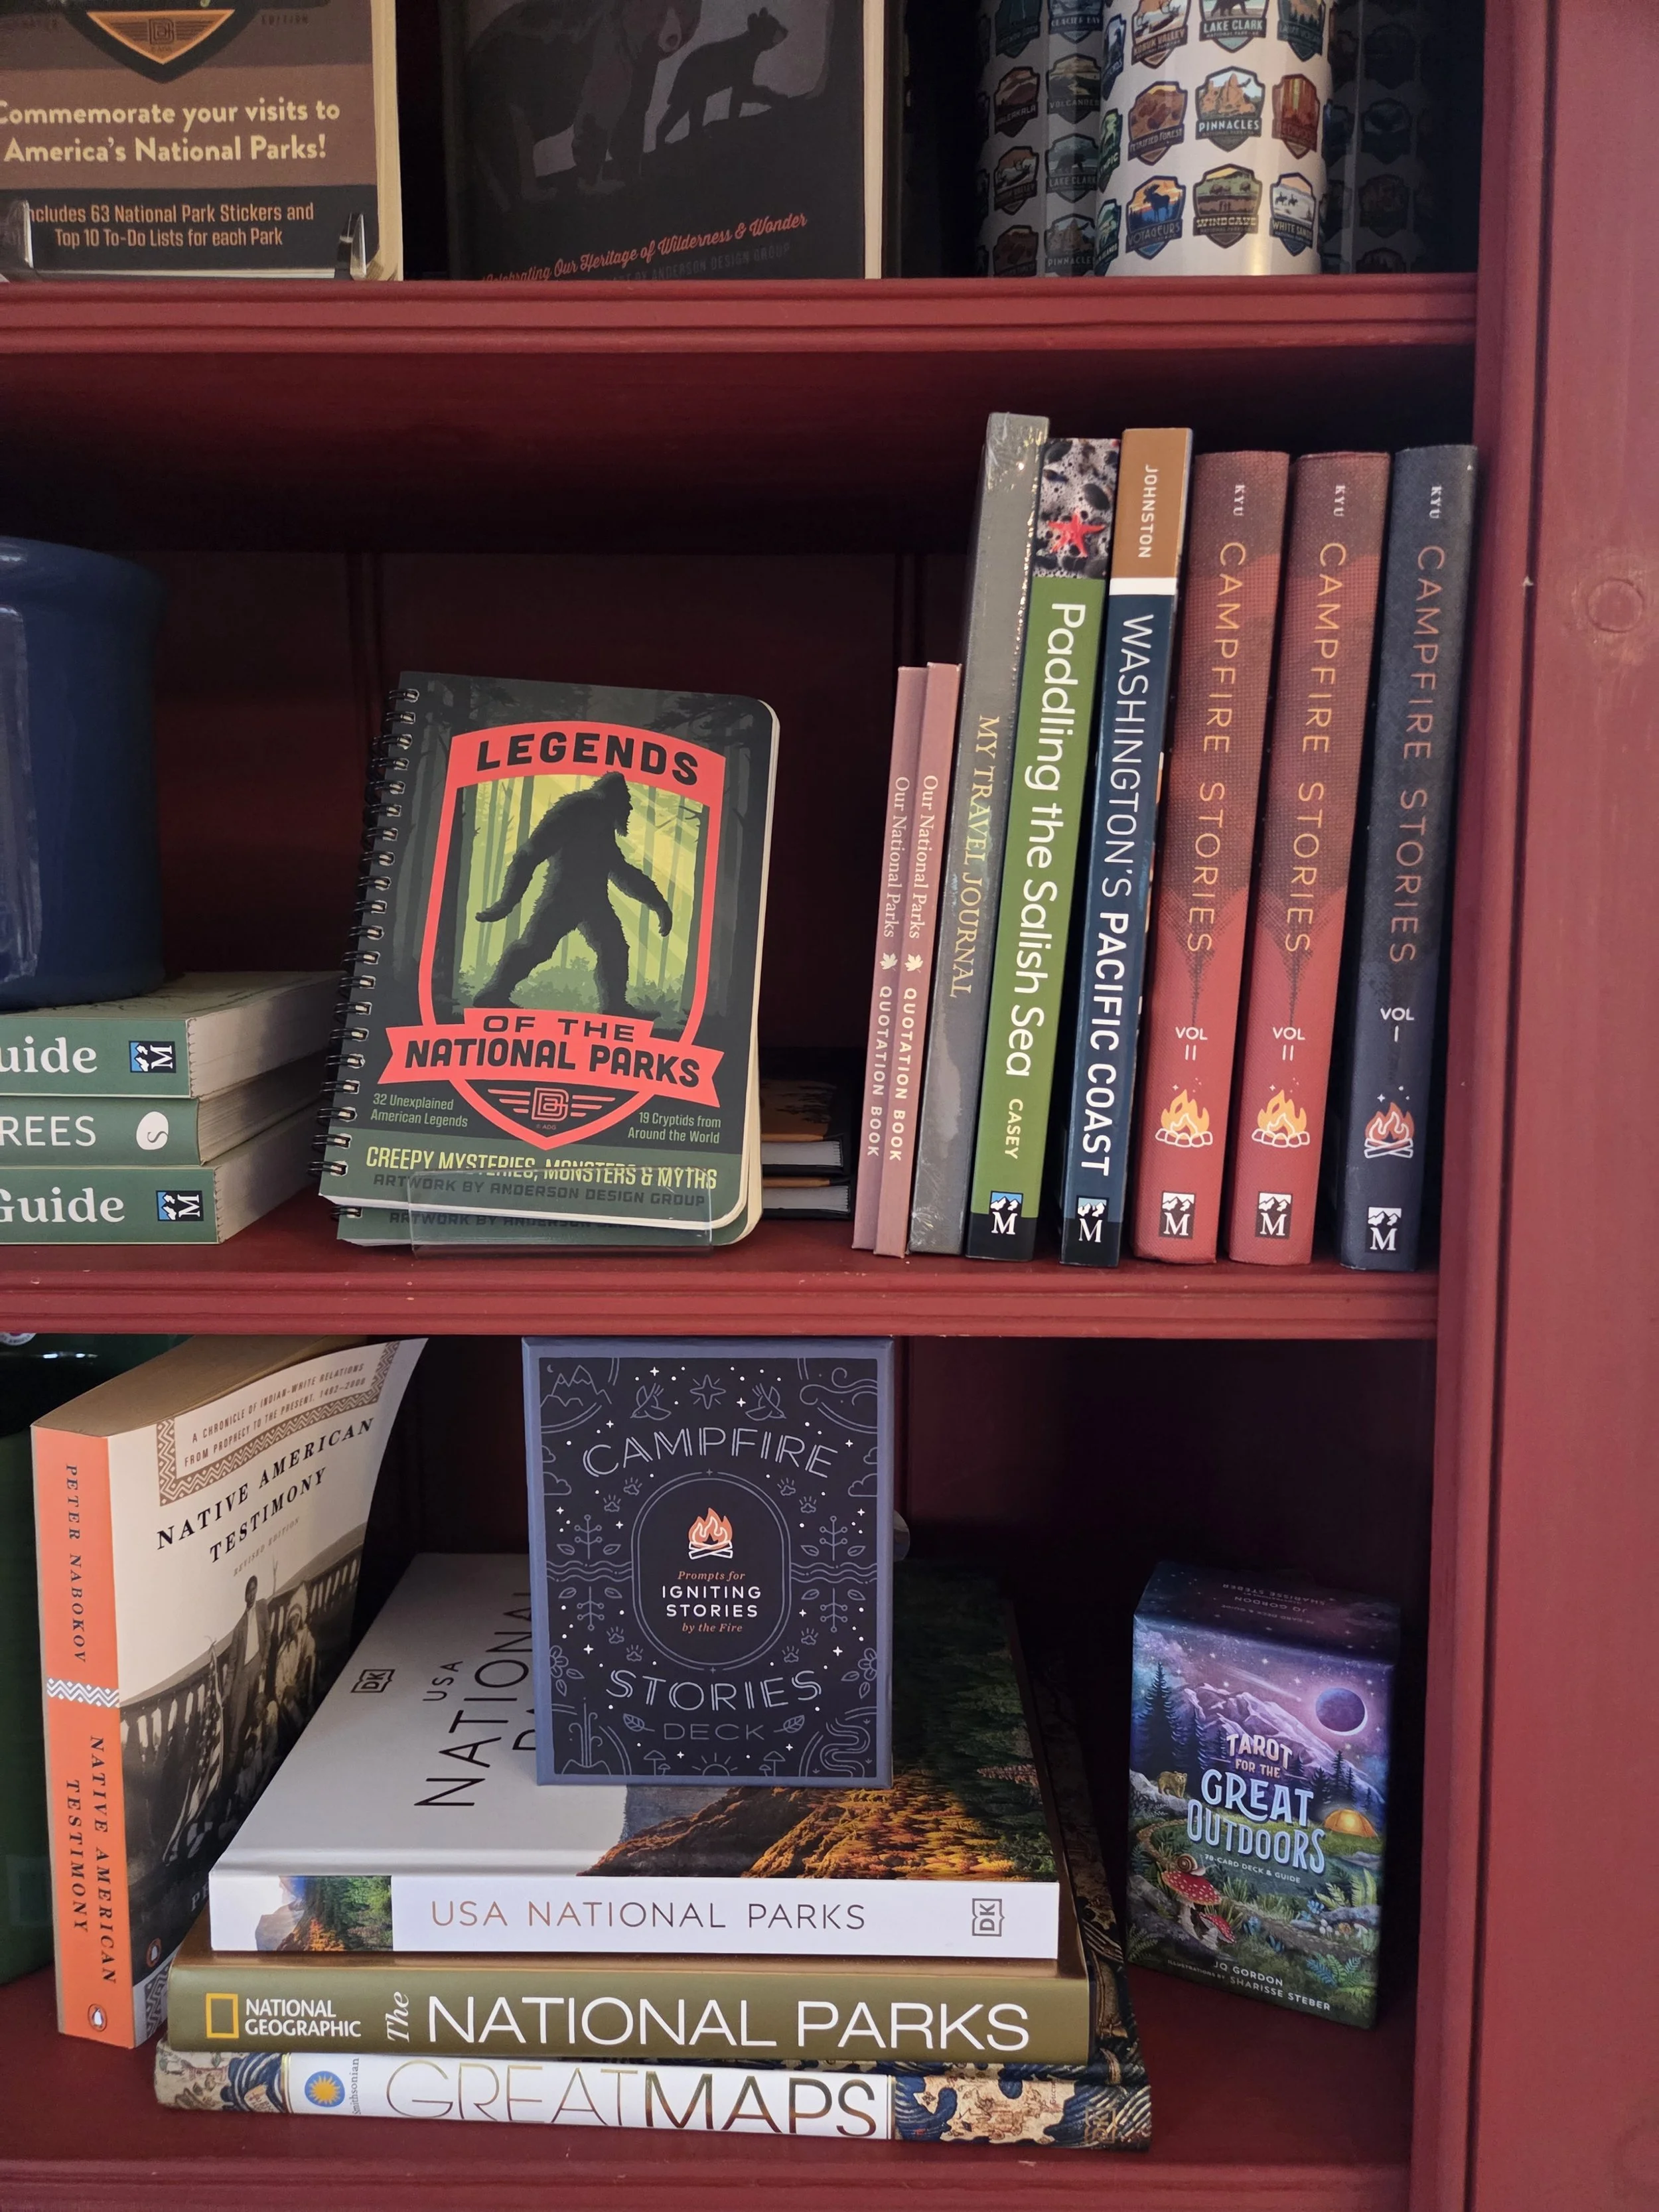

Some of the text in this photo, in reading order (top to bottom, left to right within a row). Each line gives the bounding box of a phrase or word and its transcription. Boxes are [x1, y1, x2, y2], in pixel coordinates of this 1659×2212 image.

[1157, 29, 1185, 48] VALLEY
[1203, 19, 1263, 33] LAKE CLARK
[183, 106, 238, 133] your
[245, 97, 308, 121] visits
[316, 100, 340, 121] to
[1198, 119, 1260, 131] PINNACLES
[3, 133, 326, 162] America's National Parks!
[90, 202, 314, 223] 63 National Park Stickers and
[1272, 219, 1295, 233] WHITE
[54, 227, 283, 250] Top 10 To-Do Lists for each Park
[553, 212, 808, 277] Our Heritage of Wilderness & Wonder
[1127, 224, 1181, 246] VOYAGEURS
[652, 259, 707, 280] ANDERSON
[711, 251, 750, 270] DESIGN
[754, 242, 791, 262] GROUP
[1137, 465, 1159, 558] JOHNSTON
[1232, 484, 1246, 516] KYU
[1333, 484, 1346, 517] KYU
[1428, 485, 1443, 520] KYU
[476, 731, 698, 786] LEGENDS
[1187, 542, 1246, 952] CAMPFIRE STORIES
[1285, 542, 1347, 952] CAMPFIRE STORIES
[1390, 545, 1445, 963] CAMPFIRE STORIES
[883, 776, 910, 938] Our National Parks
[909, 774, 938, 939] Our National Parks
[950, 714, 1000, 997] MY TRAVEL JOURNAL
[1005, 603, 1086, 1076] Paddling the Salish Sea
[1081, 615, 1155, 1177] WASHINGTON'S PACIFIC COAST
[482, 1015, 635, 1043] OF THE
[1380, 1007, 1415, 1021] VOL
[1175, 1027, 1208, 1041] VOL
[1272, 1027, 1305, 1041] VOL
[0, 1036, 98, 1074] uide
[405, 1037, 701, 1088] NATIONAL PARKS
[1185, 1045, 1196, 1061] II
[1282, 1045, 1293, 1061] II
[867, 986, 892, 1156] QUOTATION BOOK
[889, 988, 917, 1161] QUOTATION BOOK
[371, 1109, 469, 1128] American Legends
[373, 1093, 454, 1111] 32 Unexplained
[628, 1127, 720, 1144] Around the World
[638, 1112, 721, 1128] 19 Cryptids from
[1005, 1098, 1024, 1159] CASEY
[366, 1146, 717, 1189] CREEPY MONSTERS & MYTHS
[373, 1173, 705, 1207] ARTWORK BY ANDERSON DESIGN GROUP
[390, 1212, 470, 1226] ARTWORK
[192, 1363, 365, 1443] A CHRONICLE OF INDIAN-WHITE RELATIONS
[184, 1409, 277, 1467] FROM PROPHECY TO THE
[582, 1428, 838, 1478] CAMPFIRE
[157, 1417, 374, 1550] NATIVE AMERICAN
[210, 1467, 326, 1563] TESTIMONY
[268, 1518, 299, 1546] EDITION
[66, 1464, 86, 1662] PETER NABOKOV
[677, 1570, 745, 1582] Prompts for
[662, 1585, 761, 1599] IGNITING
[1234, 1596, 1288, 1609] GORDON
[666, 1603, 758, 1617] STORIES
[682, 1623, 743, 1634] by the Fire
[423, 1661, 463, 1701] USA
[606, 1669, 822, 1711] STORIES
[664, 1723, 765, 1740] DECK
[1226, 1733, 1293, 1770] TAROT
[1235, 1759, 1281, 1779] FOR THE
[1201, 1768, 1314, 1827] GREAT
[1187, 1799, 1326, 1876] OUTDOORS
[66, 1779, 88, 1933] TESTIMONY
[90, 1735, 117, 1984] NATIVE AMERICAN
[1242, 1863, 1264, 1874] DECK
[1275, 1872, 1301, 1883] GUIDE
[431, 1900, 866, 1931] USA NATIONAL PARKS
[1213, 1960, 1284, 1987] JO GORDON
[246, 1998, 336, 2018] NATIONAL
[1230, 1975, 1284, 1998] SHARISSE
[1287, 1991, 1331, 2012] STEBER
[244, 2018, 362, 2038] GEOGRAPHIC
[385, 1991, 1030, 2051] The NATIONAL PARKS
[348, 2057, 360, 2115] Smithsonian
